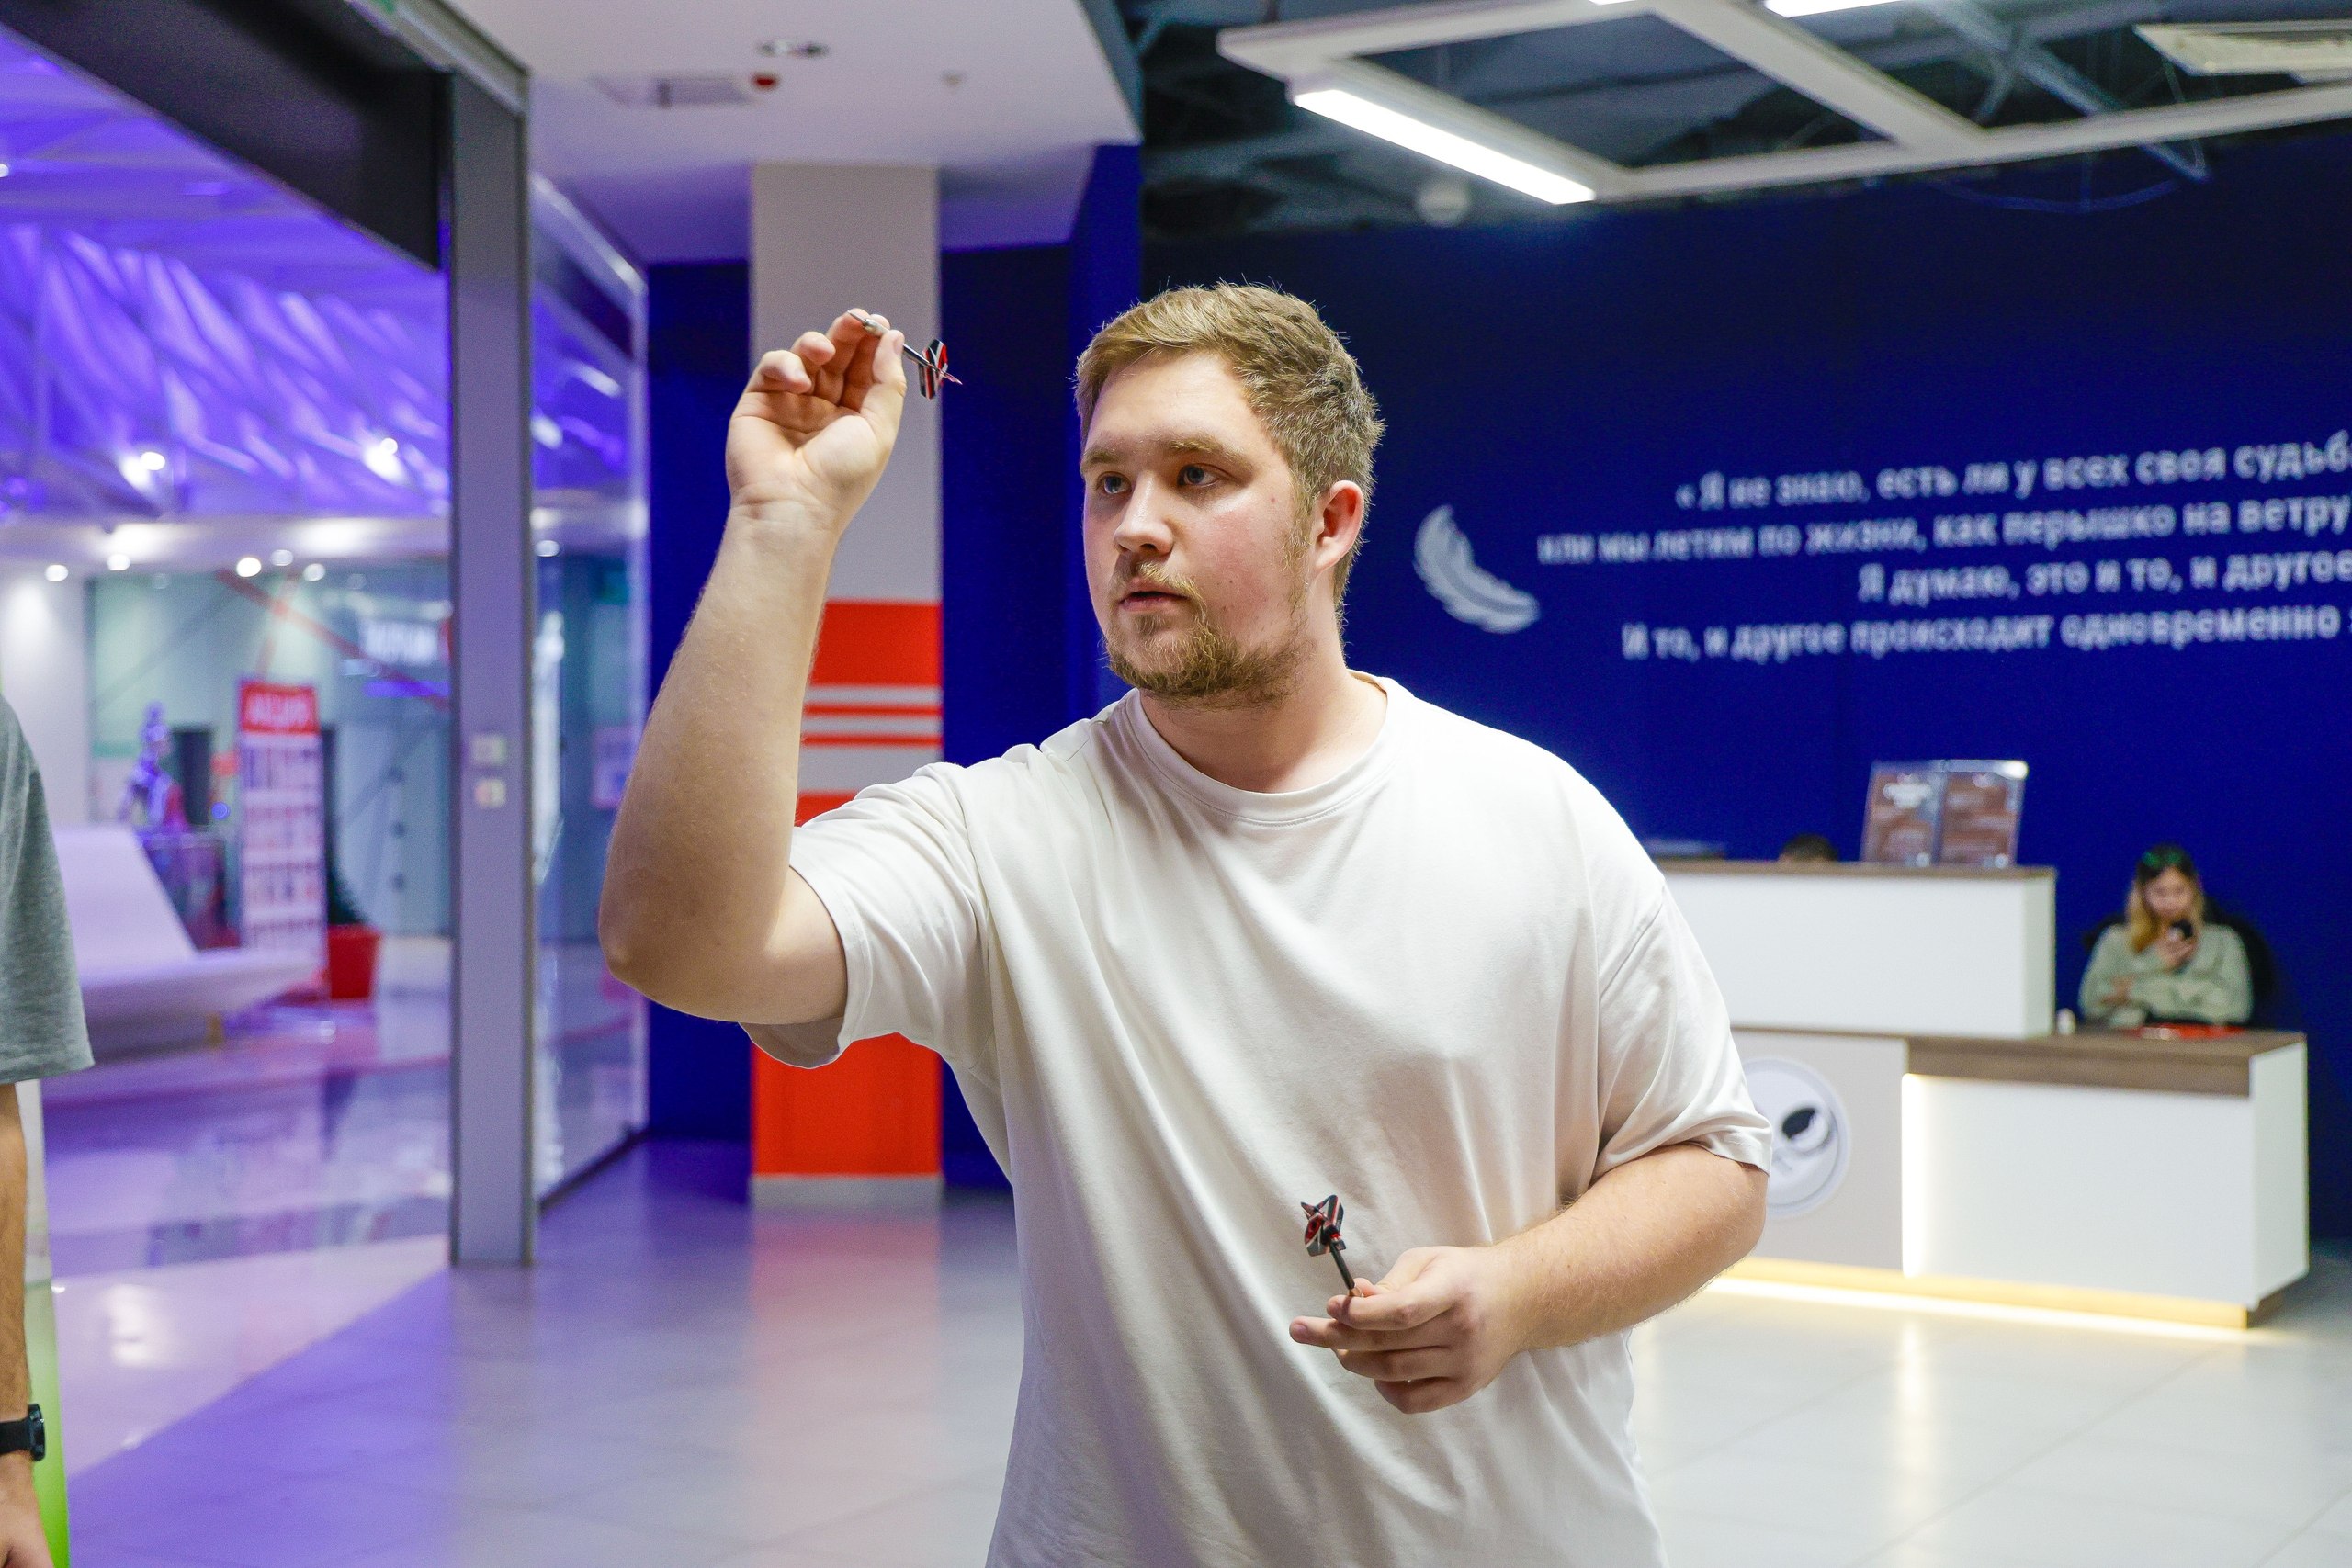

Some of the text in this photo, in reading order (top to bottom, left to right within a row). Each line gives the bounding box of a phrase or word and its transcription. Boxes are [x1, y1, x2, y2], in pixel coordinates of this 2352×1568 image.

[1729, 477, 1771, 506] не
[1876, 466, 1958, 499] есть
[1962, 462, 2009, 493] ли
[2014, 461, 2037, 498] у
[2043, 455, 2128, 490] всех
[2135, 447, 2226, 483] своя
[2233, 430, 2352, 482] судьб
[1537, 495, 2351, 563] или мы летим по жизни, как перышко на ветру
[1859, 563, 1884, 601] Я
[1889, 566, 2020, 606] думаю,
[2027, 561, 2090, 595] это
[2095, 560, 2121, 592] и
[2126, 558, 2183, 593] то,
[2190, 556, 2217, 589] и
[1621, 605, 2341, 663] И то, и другое происходит одновременно
